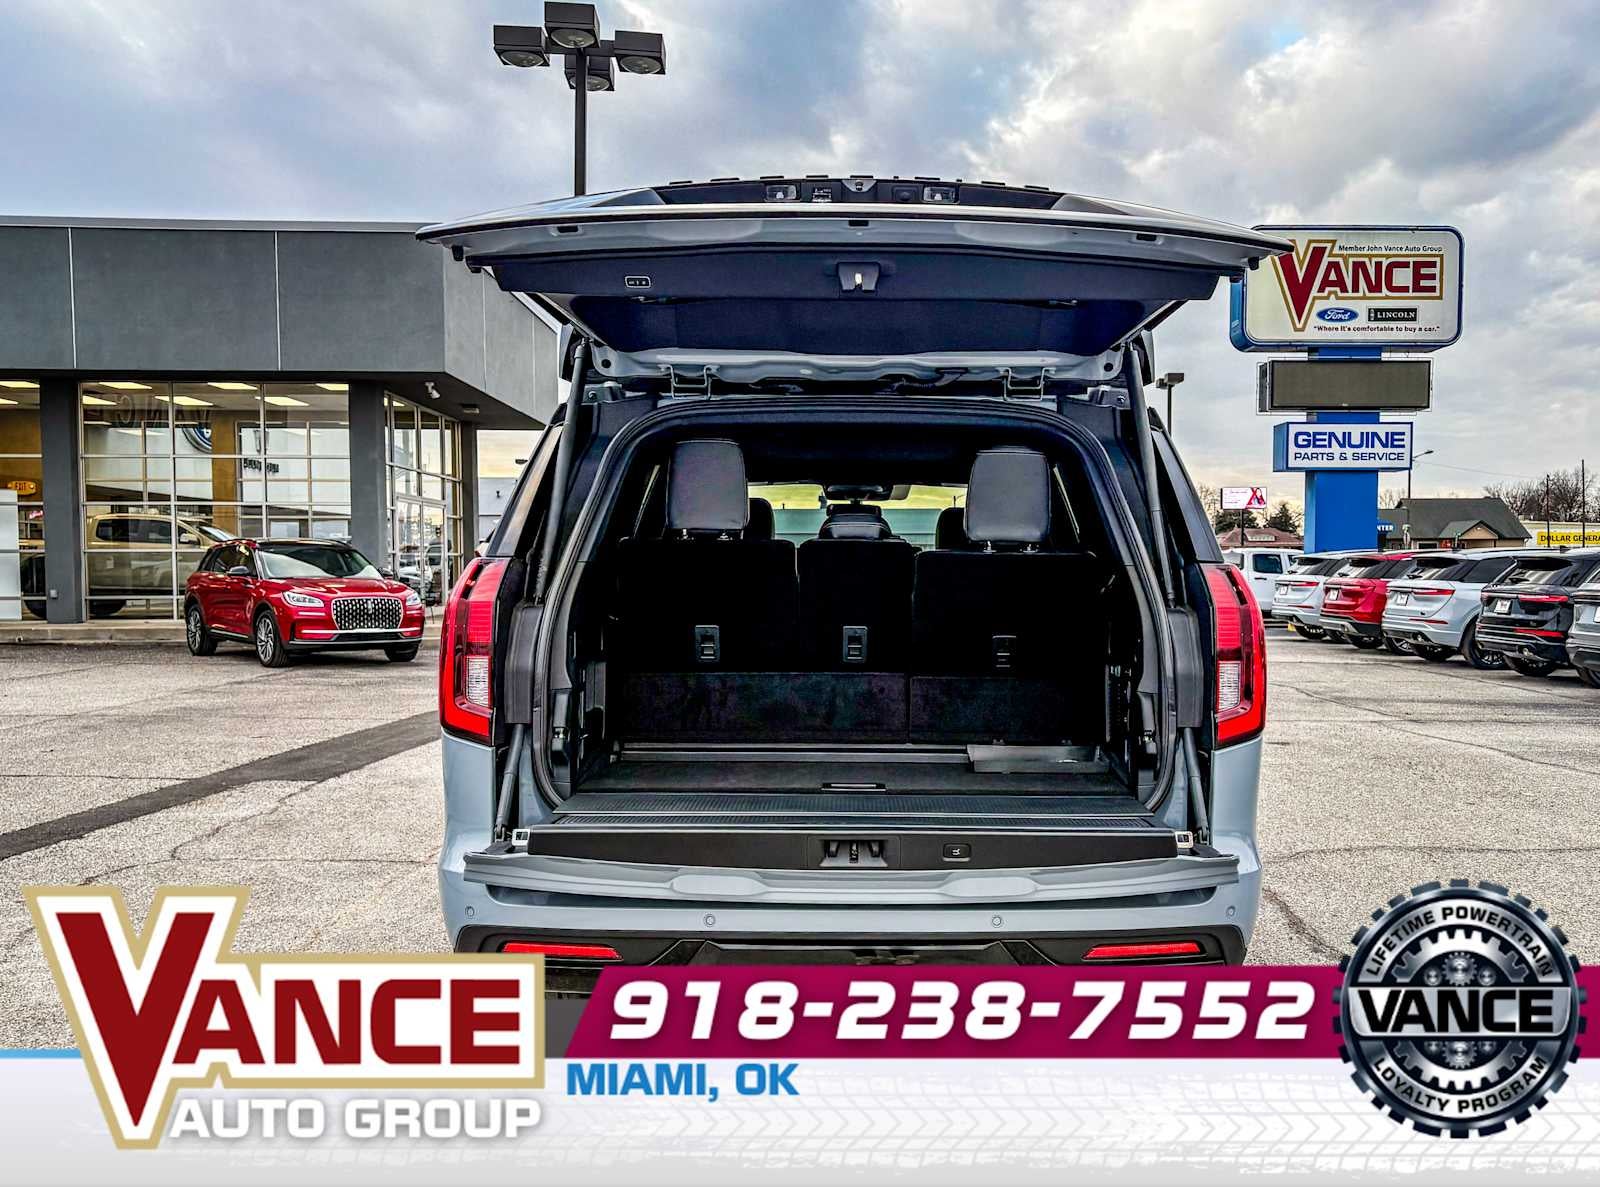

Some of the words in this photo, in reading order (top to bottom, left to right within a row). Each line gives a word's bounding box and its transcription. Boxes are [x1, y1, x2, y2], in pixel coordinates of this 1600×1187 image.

[1422, 245, 1443, 253] Group
[1276, 246, 1437, 325] VANCE
[1377, 311, 1416, 319] LINCOLN
[1404, 325, 1417, 333] buy
[1293, 431, 1406, 449] GENUINE
[1294, 452, 1335, 461] PARTS
[1338, 452, 1349, 461] &
[1351, 452, 1405, 461] SERVICE
